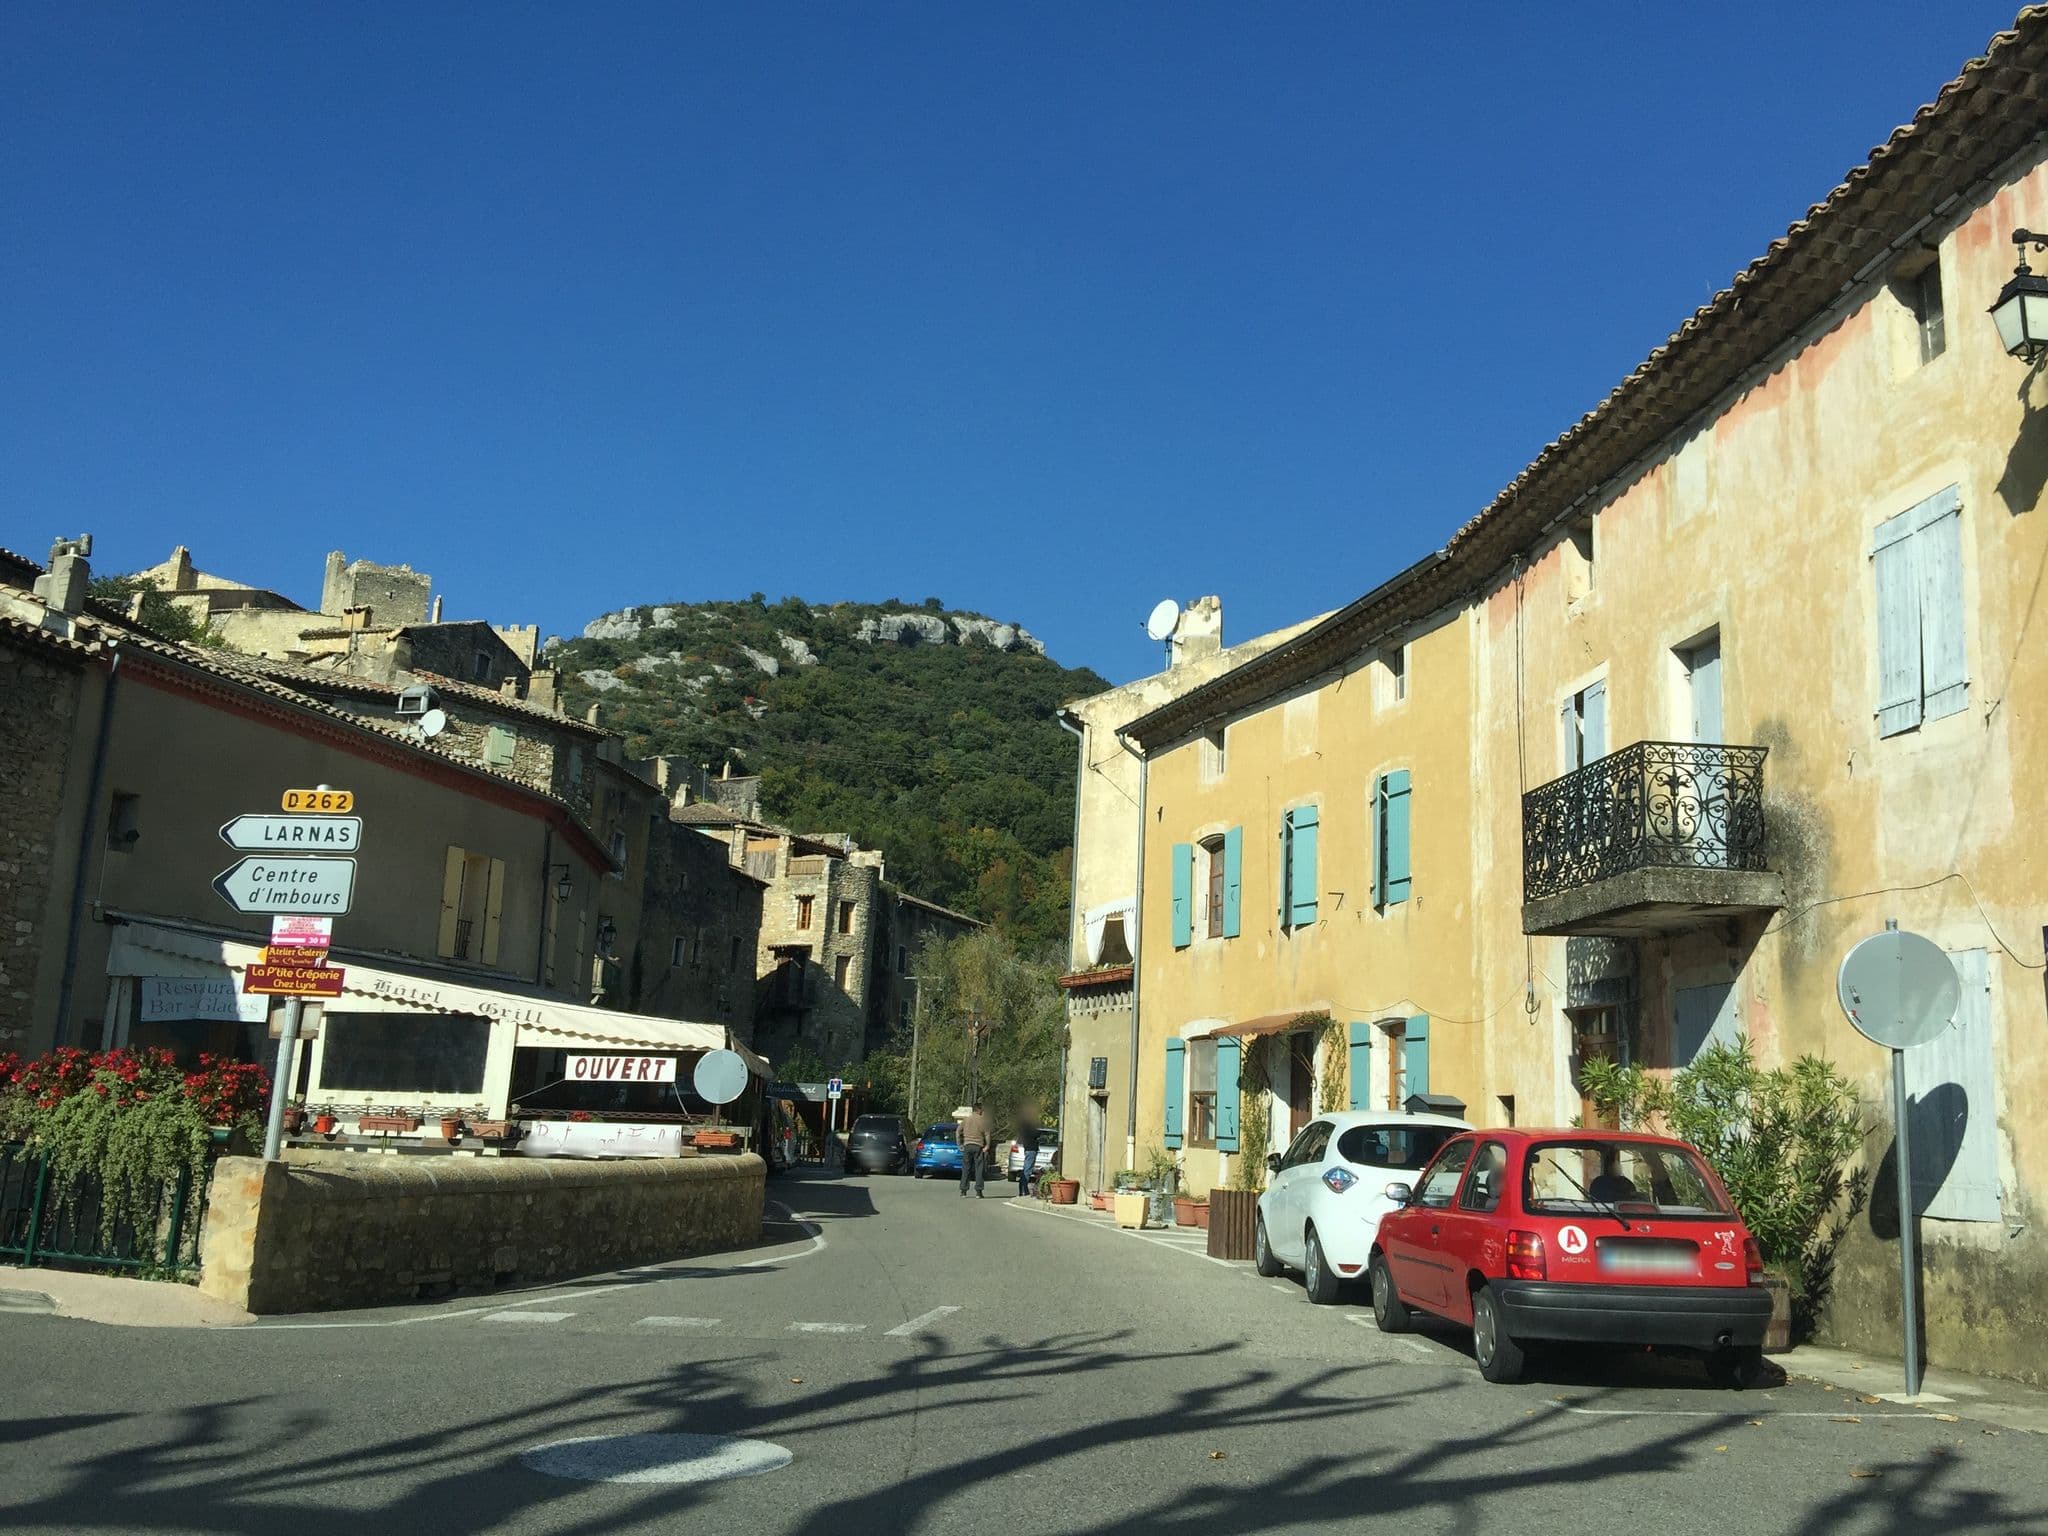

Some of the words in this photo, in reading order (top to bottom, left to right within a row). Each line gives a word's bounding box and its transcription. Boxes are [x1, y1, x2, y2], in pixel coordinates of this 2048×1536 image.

[288, 793, 299, 808] D
[306, 794, 348, 809] 262
[264, 825, 350, 842] LARNAS
[251, 866, 318, 883] Centre
[248, 888, 341, 905] d'Imbours
[268, 947, 296, 956] Atelier
[252, 966, 265, 977] La
[267, 966, 294, 978] P'tite
[295, 967, 340, 981] Crêperie
[273, 979, 294, 988] Chez
[296, 980, 317, 991] Lyne
[373, 978, 440, 1003] Hôtel
[478, 1002, 543, 1024] Grill
[575, 1057, 667, 1081] OUVERT
[1566, 1229, 1582, 1249] A
